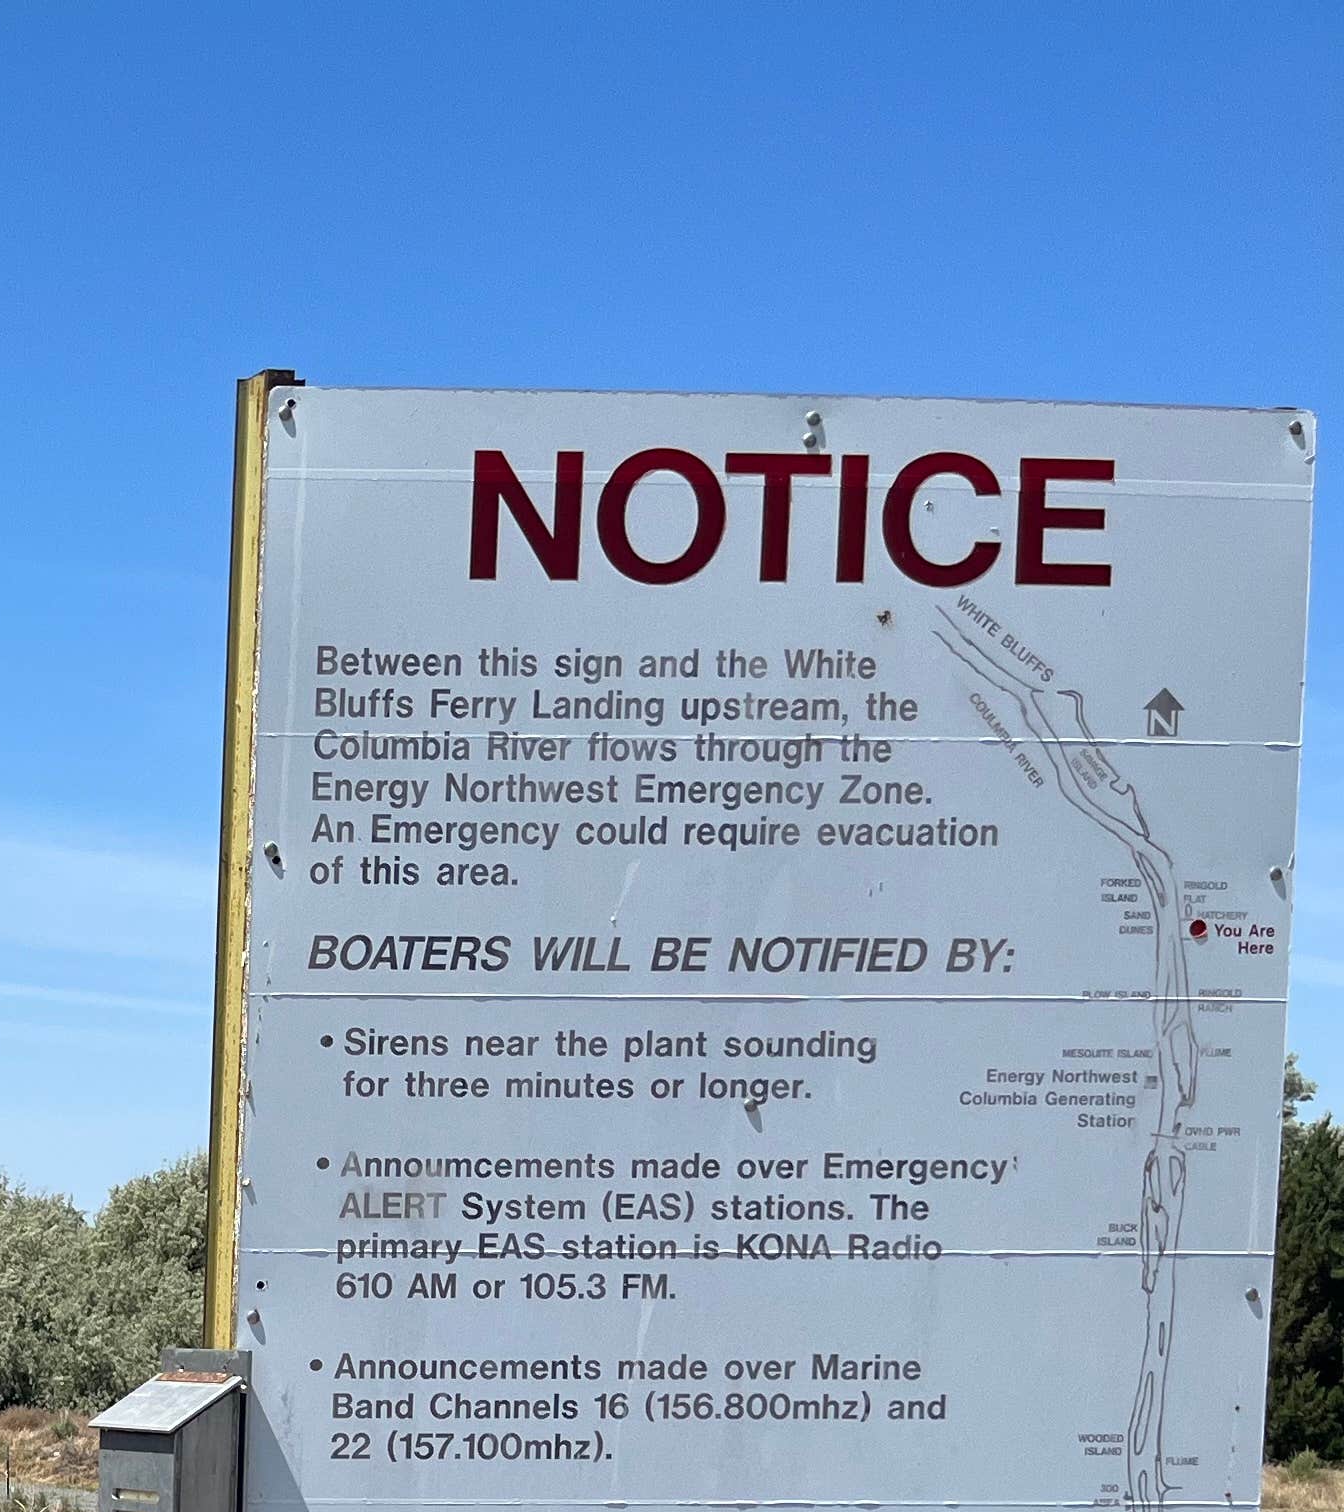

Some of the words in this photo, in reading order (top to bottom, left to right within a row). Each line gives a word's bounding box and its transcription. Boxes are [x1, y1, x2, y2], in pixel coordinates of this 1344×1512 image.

[468, 447, 1116, 588] NOTICE
[956, 594, 1002, 638] WHITE
[1000, 633, 1055, 683] BLUFFS
[316, 644, 462, 677] Between
[478, 645, 538, 678] this
[554, 647, 623, 685] sign
[638, 647, 700, 678] and
[715, 647, 768, 678] the
[783, 648, 877, 680] White
[314, 686, 414, 718] Bluffs
[430, 687, 517, 725] Ferry
[532, 688, 665, 727] Landing
[681, 691, 849, 728] upstream,
[865, 691, 918, 722] the
[313, 728, 471, 761] Columbia
[487, 730, 572, 762] River
[587, 730, 678, 762] flows
[694, 732, 823, 769] through
[839, 733, 893, 764] the
[1014, 753, 1045, 789] RIVER
[311, 771, 430, 809] Energy
[445, 772, 619, 804] Northwest
[635, 773, 825, 811] Emergency
[839, 776, 932, 805] Zone.
[1100, 877, 1142, 888] FORKED
[1123, 910, 1151, 921] SAND
[1214, 924, 1243, 938] You
[1248, 924, 1276, 938] Are
[307, 933, 512, 972] BOATERS
[533, 935, 631, 971] WILL
[650, 936, 713, 972] BE
[727, 935, 928, 973] NOTIFIED
[945, 936, 1015, 973] BY:
[1237, 941, 1274, 955] Here
[986, 1069, 1044, 1087] Energy
[1051, 1069, 1138, 1084] Northwest
[959, 1091, 1037, 1106] Columbia
[1045, 1091, 1136, 1109] Generating
[631, 1151, 721, 1179] made
[736, 1158, 809, 1180] over
[338, 1191, 447, 1219] ALERT
[461, 1191, 586, 1225] System
[602, 1189, 695, 1223] (EAS)
[711, 1193, 854, 1221] stations.
[869, 1193, 930, 1221] The
[1097, 1237, 1136, 1246] ISLAND
[1108, 1223, 1138, 1233] BUCK
[335, 1271, 394, 1300] 610
[407, 1272, 457, 1300] AM
[472, 1278, 506, 1300] or
[519, 1272, 607, 1300] 105.3
[622, 1272, 677, 1300] FM.
[1078, 1434, 1124, 1443] WOODED
[1084, 1447, 1122, 1456] ISLAND
